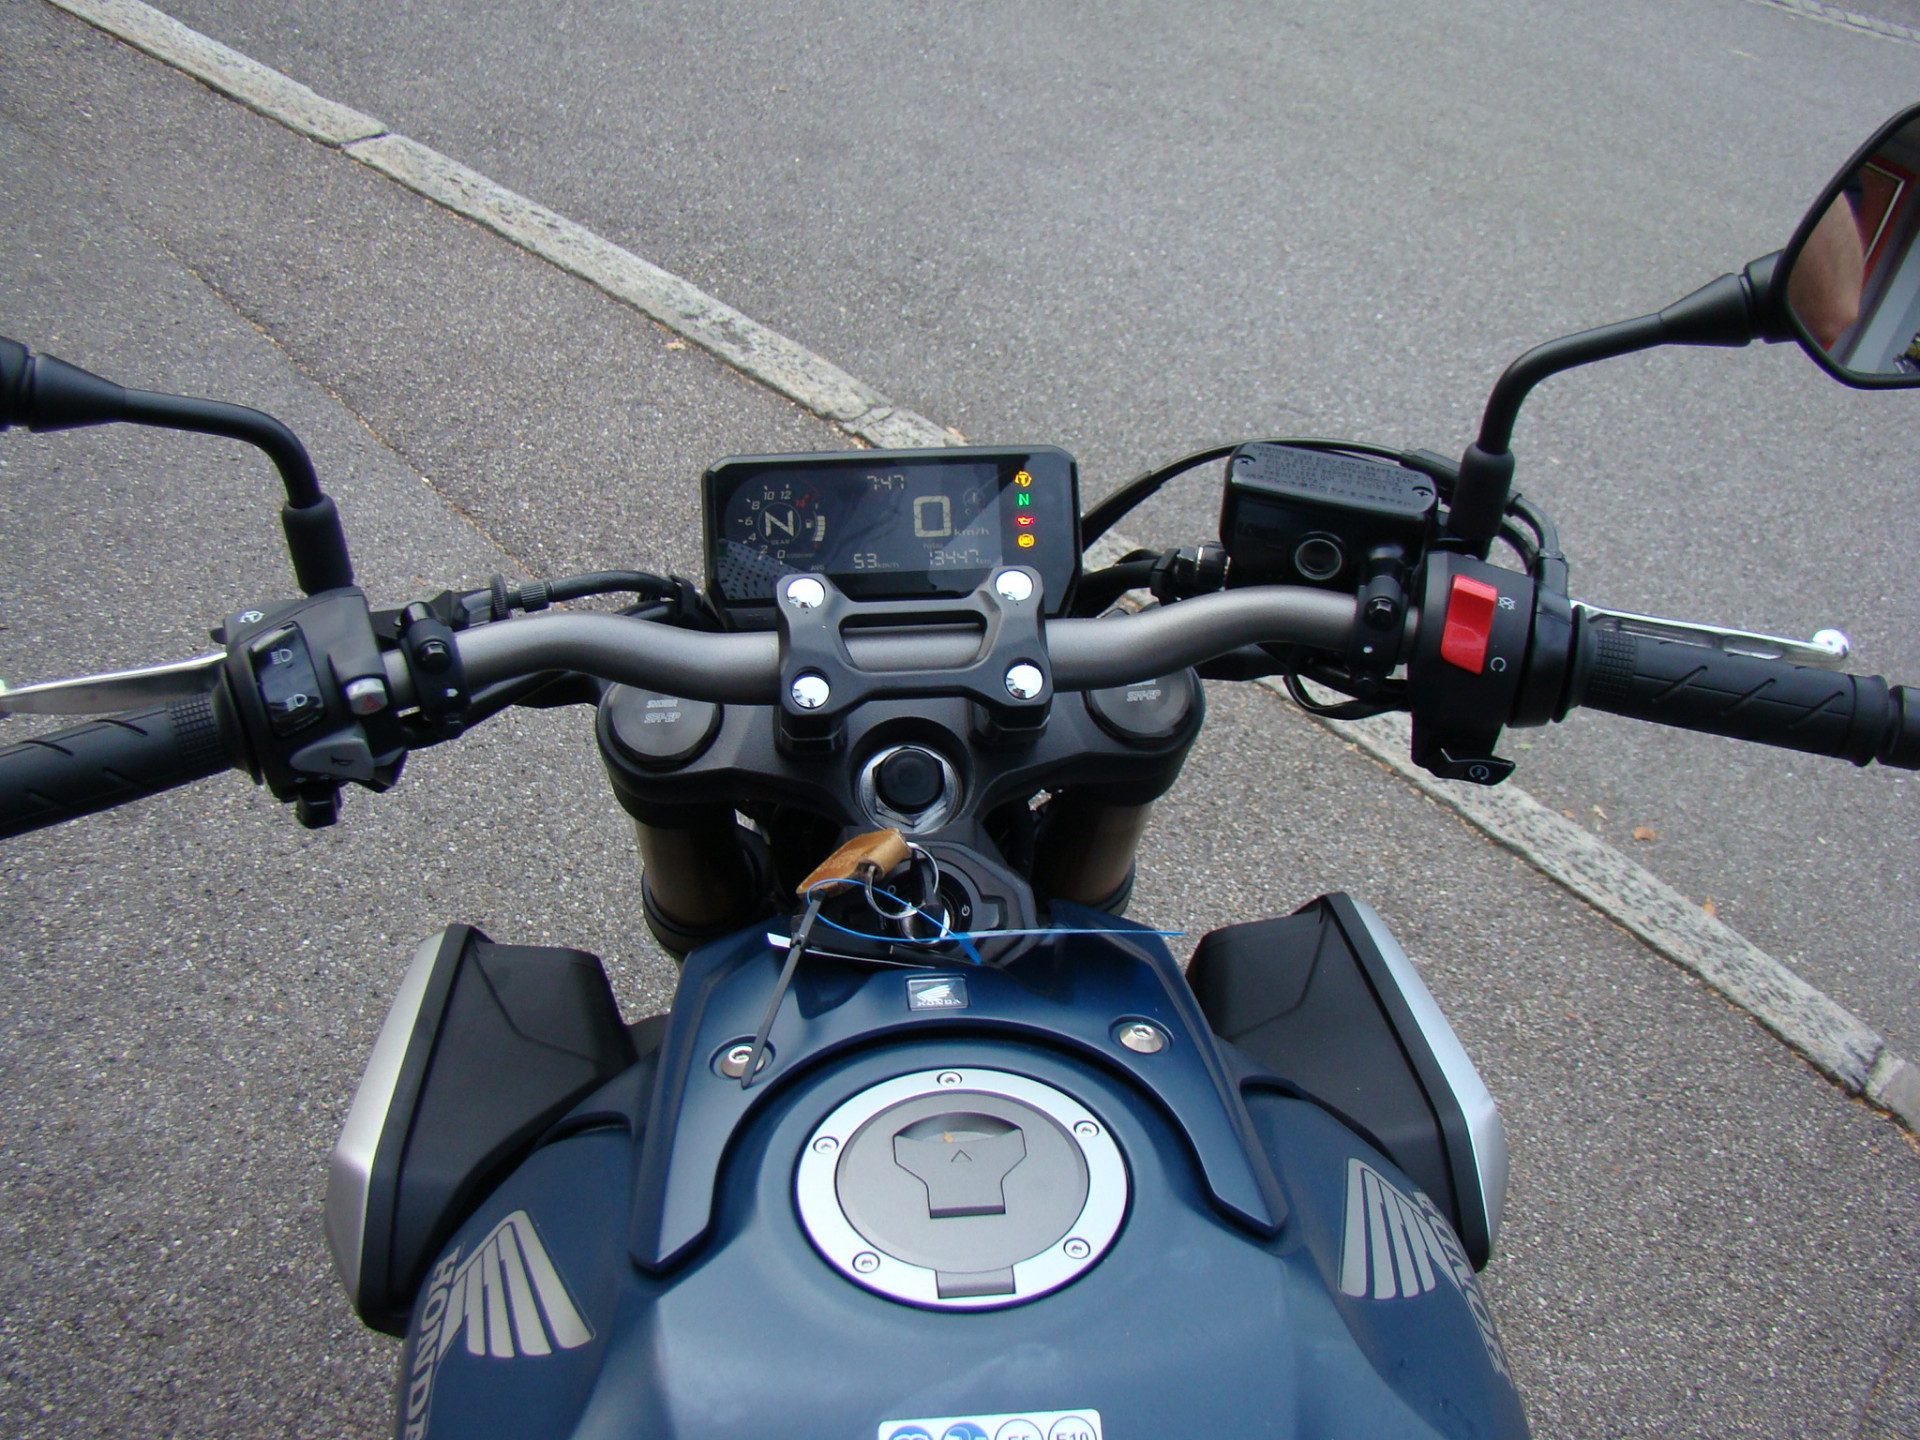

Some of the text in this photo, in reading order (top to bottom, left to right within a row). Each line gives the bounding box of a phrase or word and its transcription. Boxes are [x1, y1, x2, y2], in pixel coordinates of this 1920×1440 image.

[764, 491, 775, 500] 10
[780, 490, 792, 499] 12
[1018, 493, 1030, 506] N
[751, 501, 760, 510] 8
[913, 496, 951, 537] 0
[744, 517, 753, 526] 6
[765, 510, 794, 536] N
[954, 528, 989, 536] km/h
[748, 533, 756, 541] 4
[760, 545, 768, 553] 2
[777, 550, 786, 558] 0
[930, 549, 979, 566] 13447
[853, 553, 877, 569] 53
[917, 998, 962, 1007] HONDA
